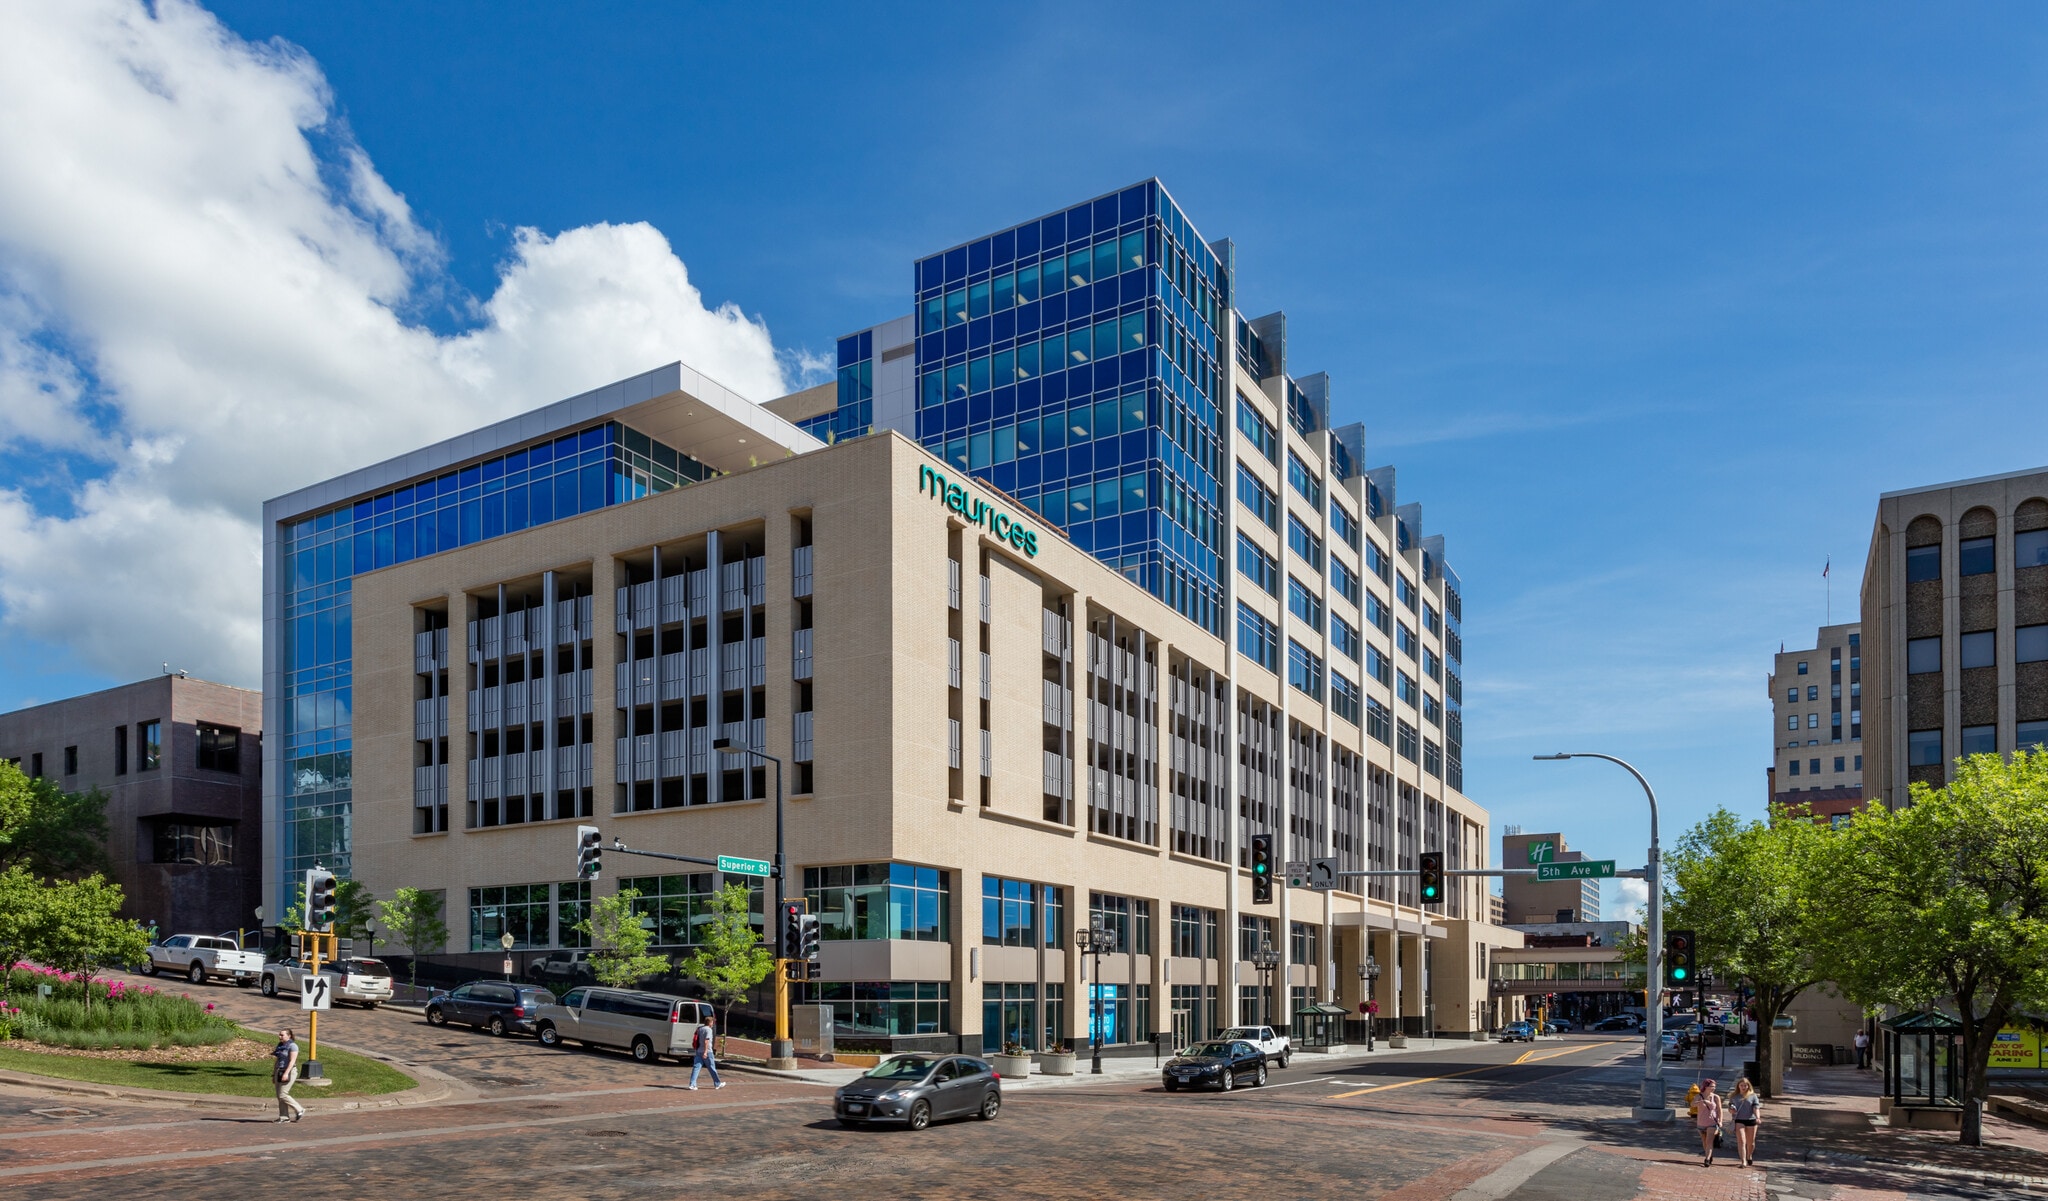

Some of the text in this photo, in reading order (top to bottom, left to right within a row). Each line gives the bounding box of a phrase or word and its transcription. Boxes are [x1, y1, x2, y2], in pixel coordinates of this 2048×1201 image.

[919, 463, 1039, 557] maurices
[721, 859, 768, 873] Superior St
[1542, 864, 1611, 877] 5th Ave W
[1314, 880, 1334, 888] ONLY
[1707, 1011, 1740, 1024] FeEx
